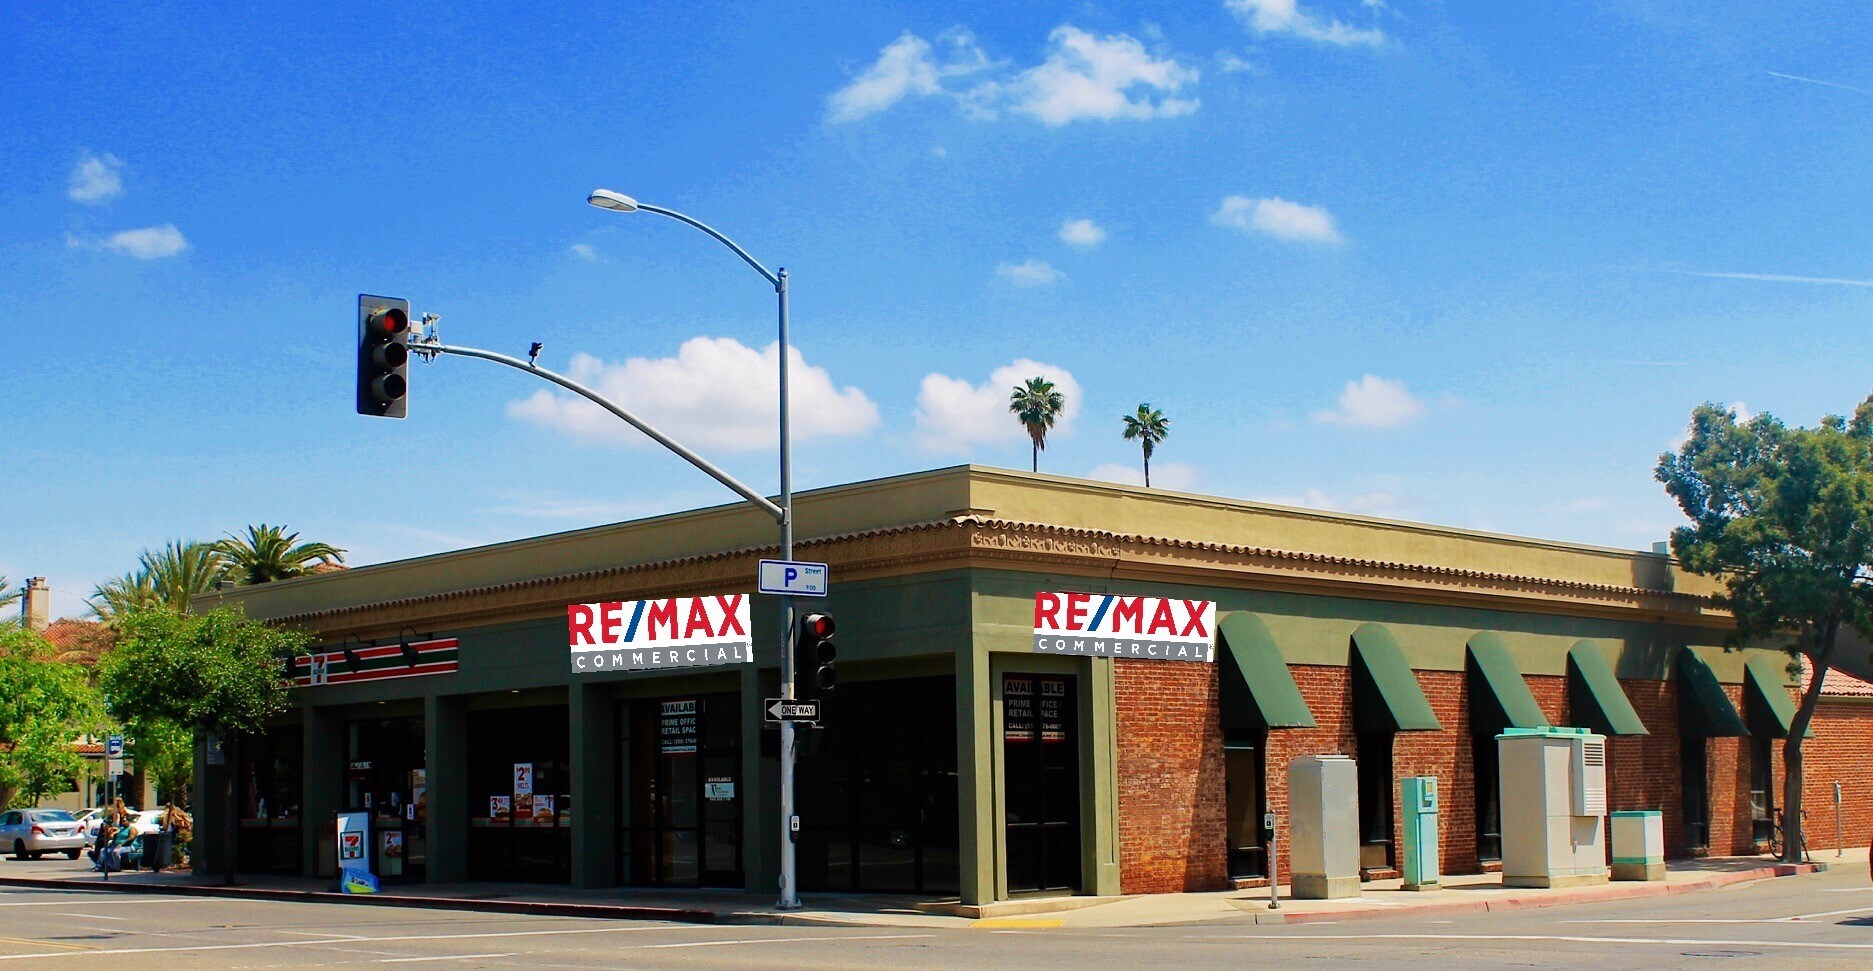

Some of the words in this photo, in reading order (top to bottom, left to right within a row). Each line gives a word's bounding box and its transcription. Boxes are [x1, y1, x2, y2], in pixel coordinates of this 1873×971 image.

[784, 568, 797, 587] P
[568, 594, 746, 646] RE/MAX
[1033, 591, 1209, 637] RE/MAX
[1038, 638, 1203, 658] COMMERCIAL
[576, 646, 742, 669] COMMERCIAL
[781, 705, 797, 715] ONE
[798, 705, 814, 715] WAY
[1009, 700, 1031, 708] PRIME
[1008, 709, 1034, 718] RETAIL
[661, 718, 679, 727] PRIME
[661, 726, 681, 735] RETAIL
